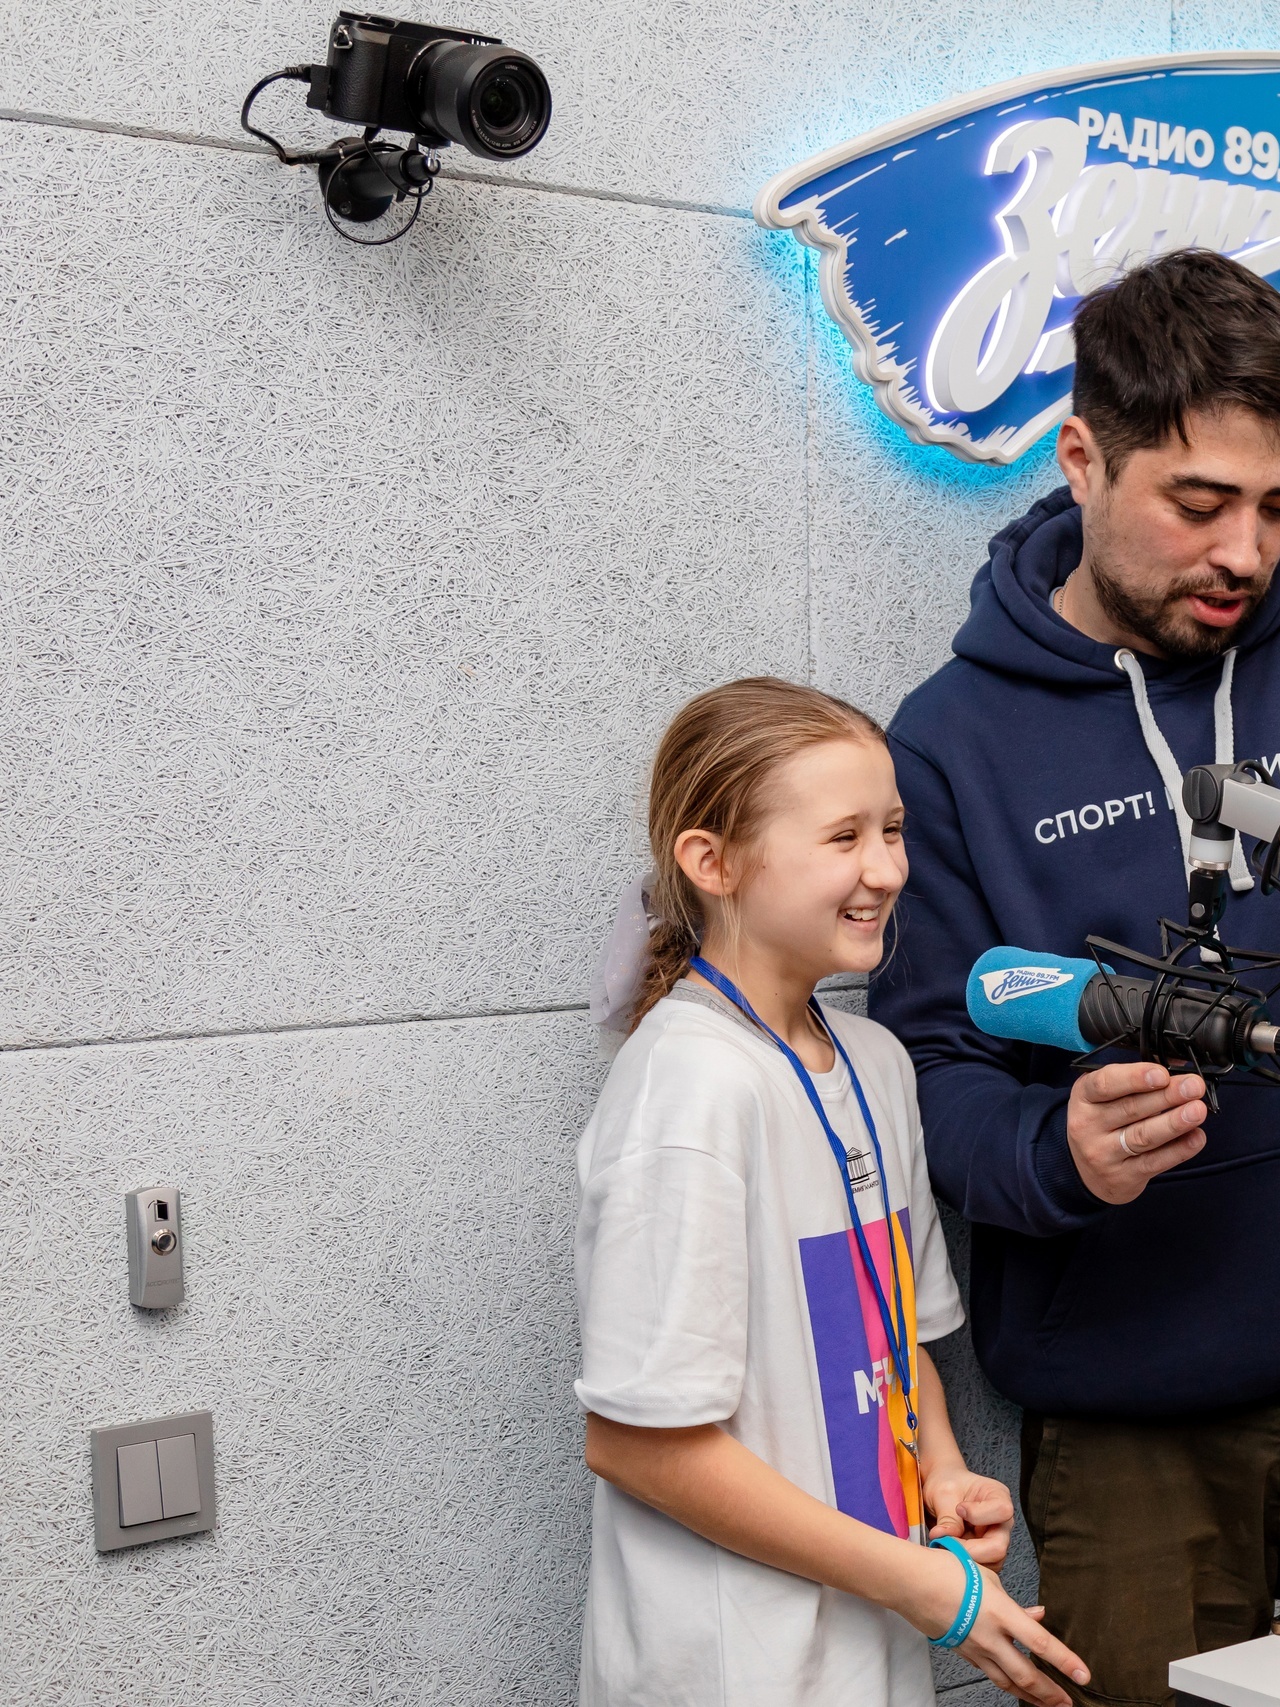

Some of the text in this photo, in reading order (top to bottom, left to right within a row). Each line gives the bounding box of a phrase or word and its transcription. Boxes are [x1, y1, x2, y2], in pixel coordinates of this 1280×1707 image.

[1078, 106, 1215, 168] РАДИО
[1033, 790, 1156, 845] СПОРТ!
[991, 970, 1056, 1001] Зенит
[956, 1595, 977, 1637] АКАДЕМИЯ
